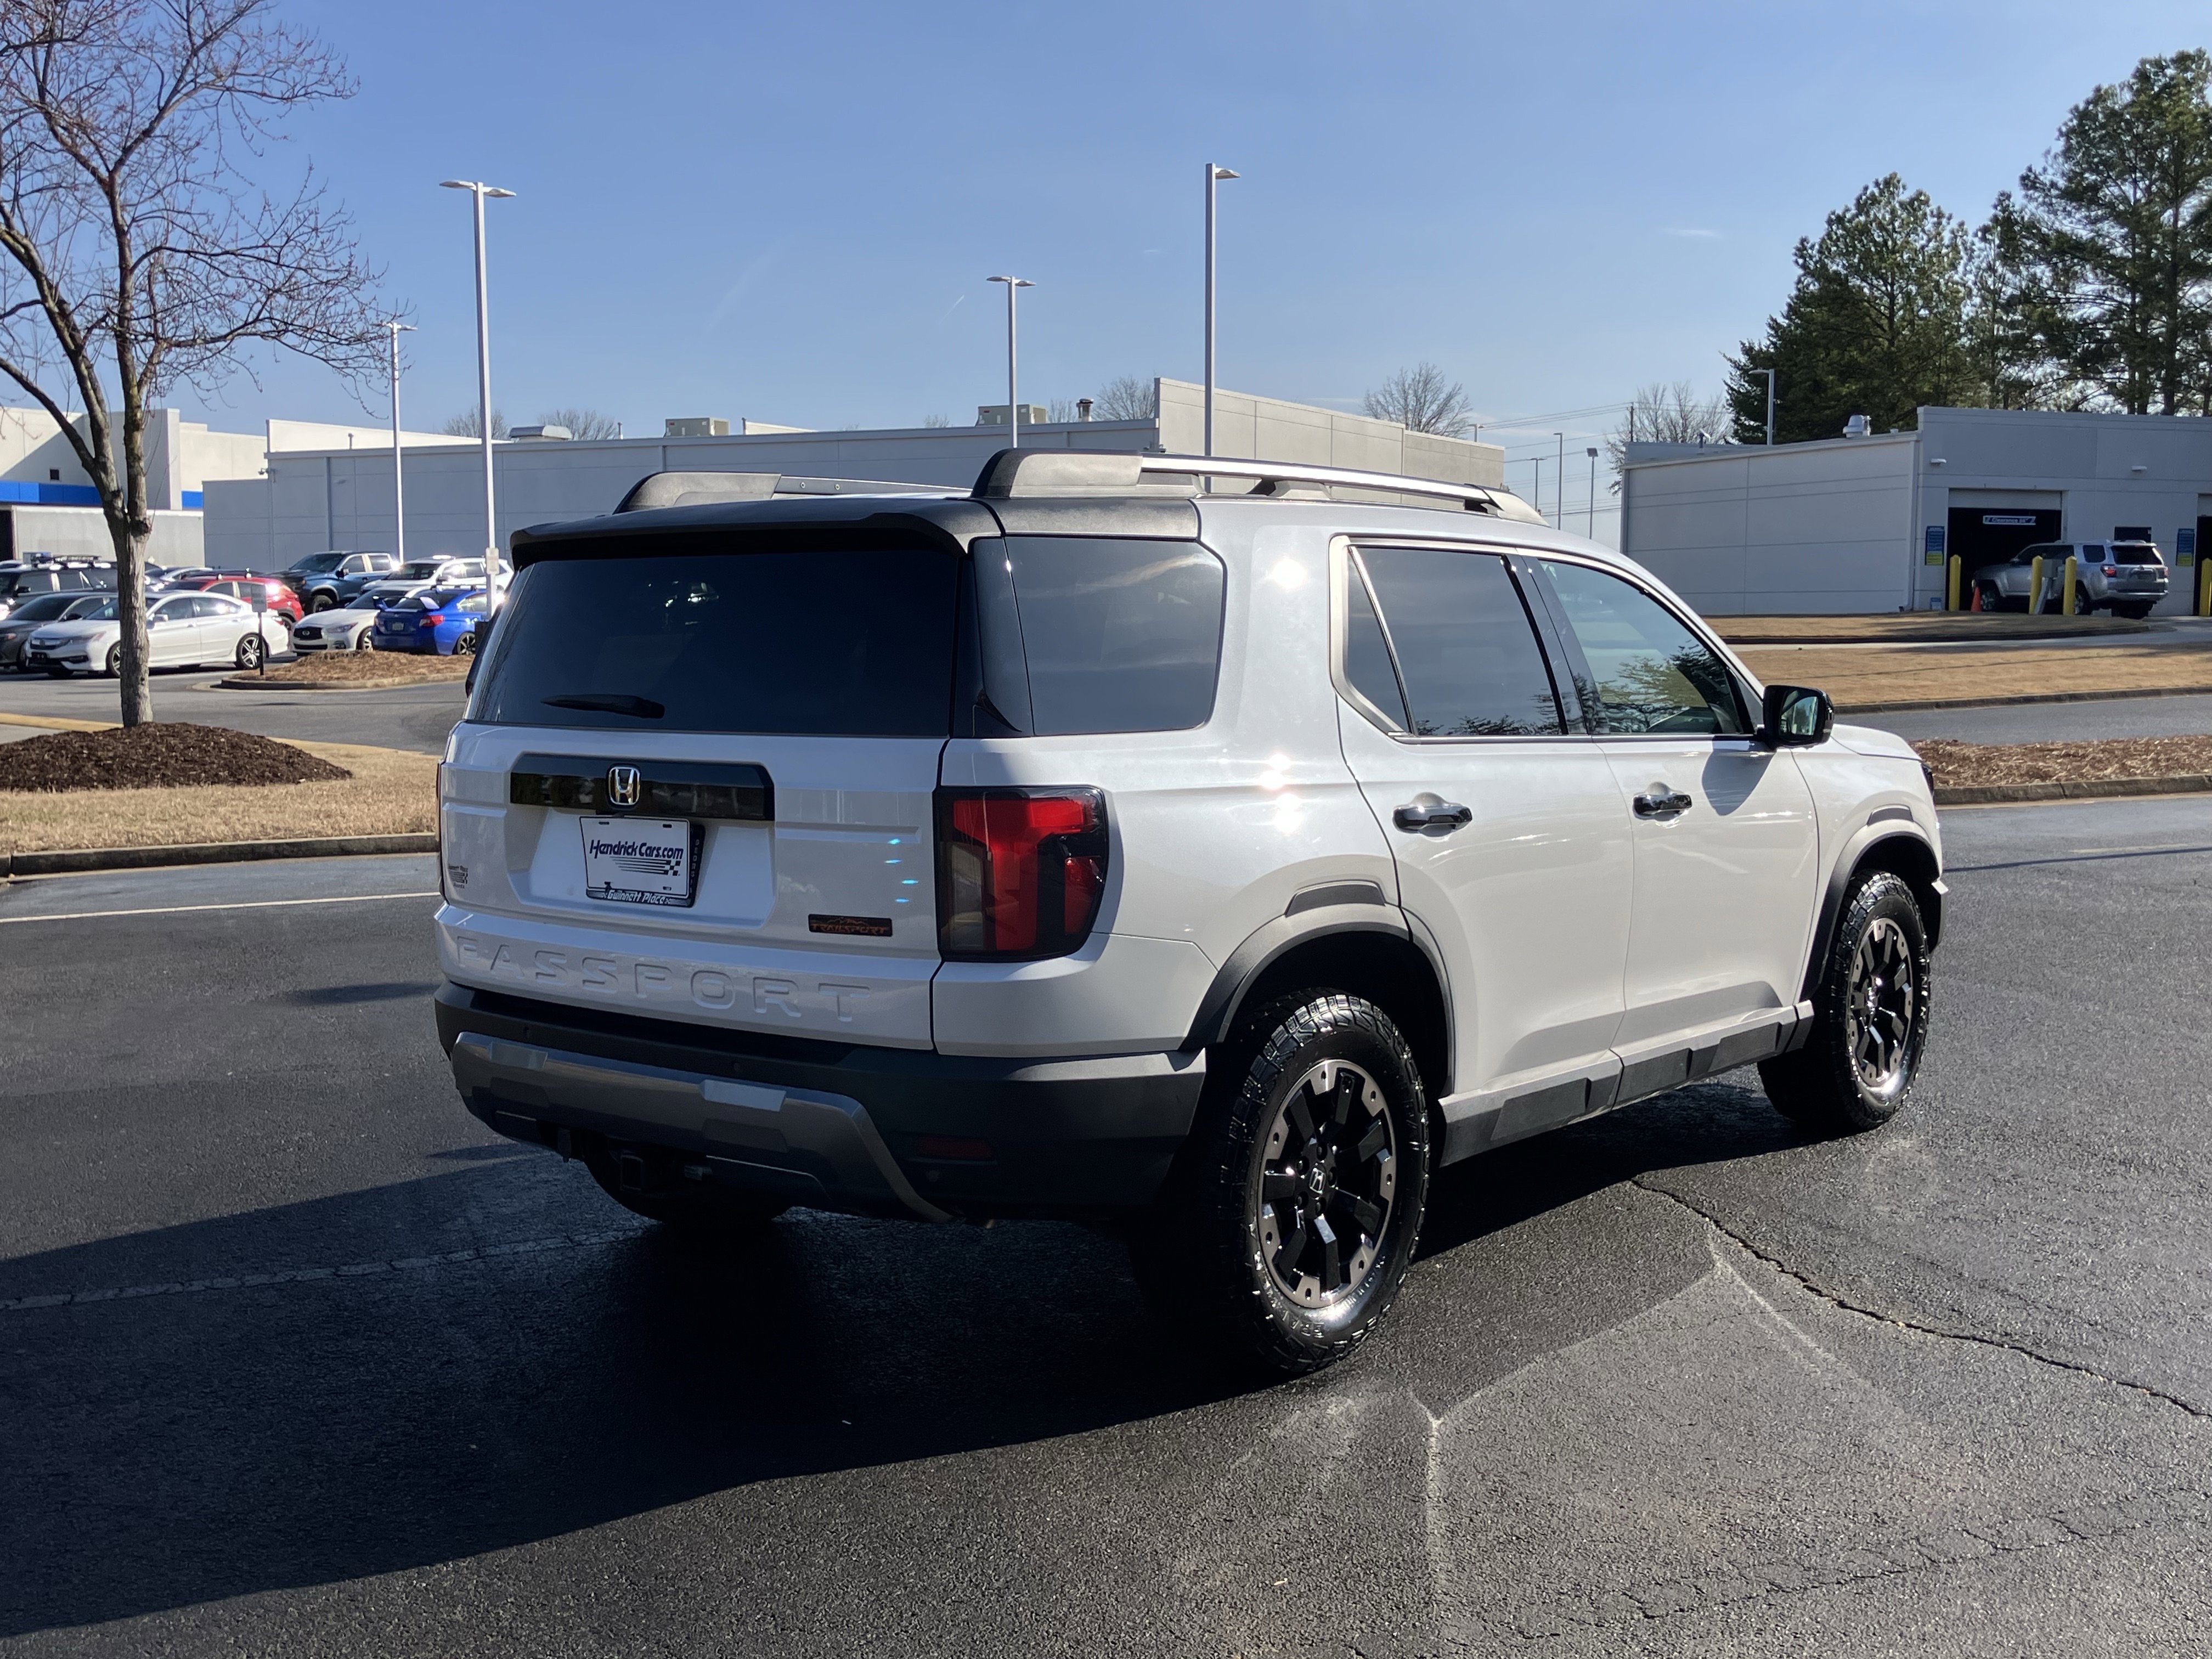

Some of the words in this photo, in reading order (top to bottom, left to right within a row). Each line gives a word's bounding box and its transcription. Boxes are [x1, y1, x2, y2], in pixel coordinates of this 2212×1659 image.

[607, 889, 641, 902] Gwinnett
[641, 892, 666, 905] Place
[810, 923, 888, 935] TRAILSPORT
[456, 936, 871, 1023] PASSPORT
